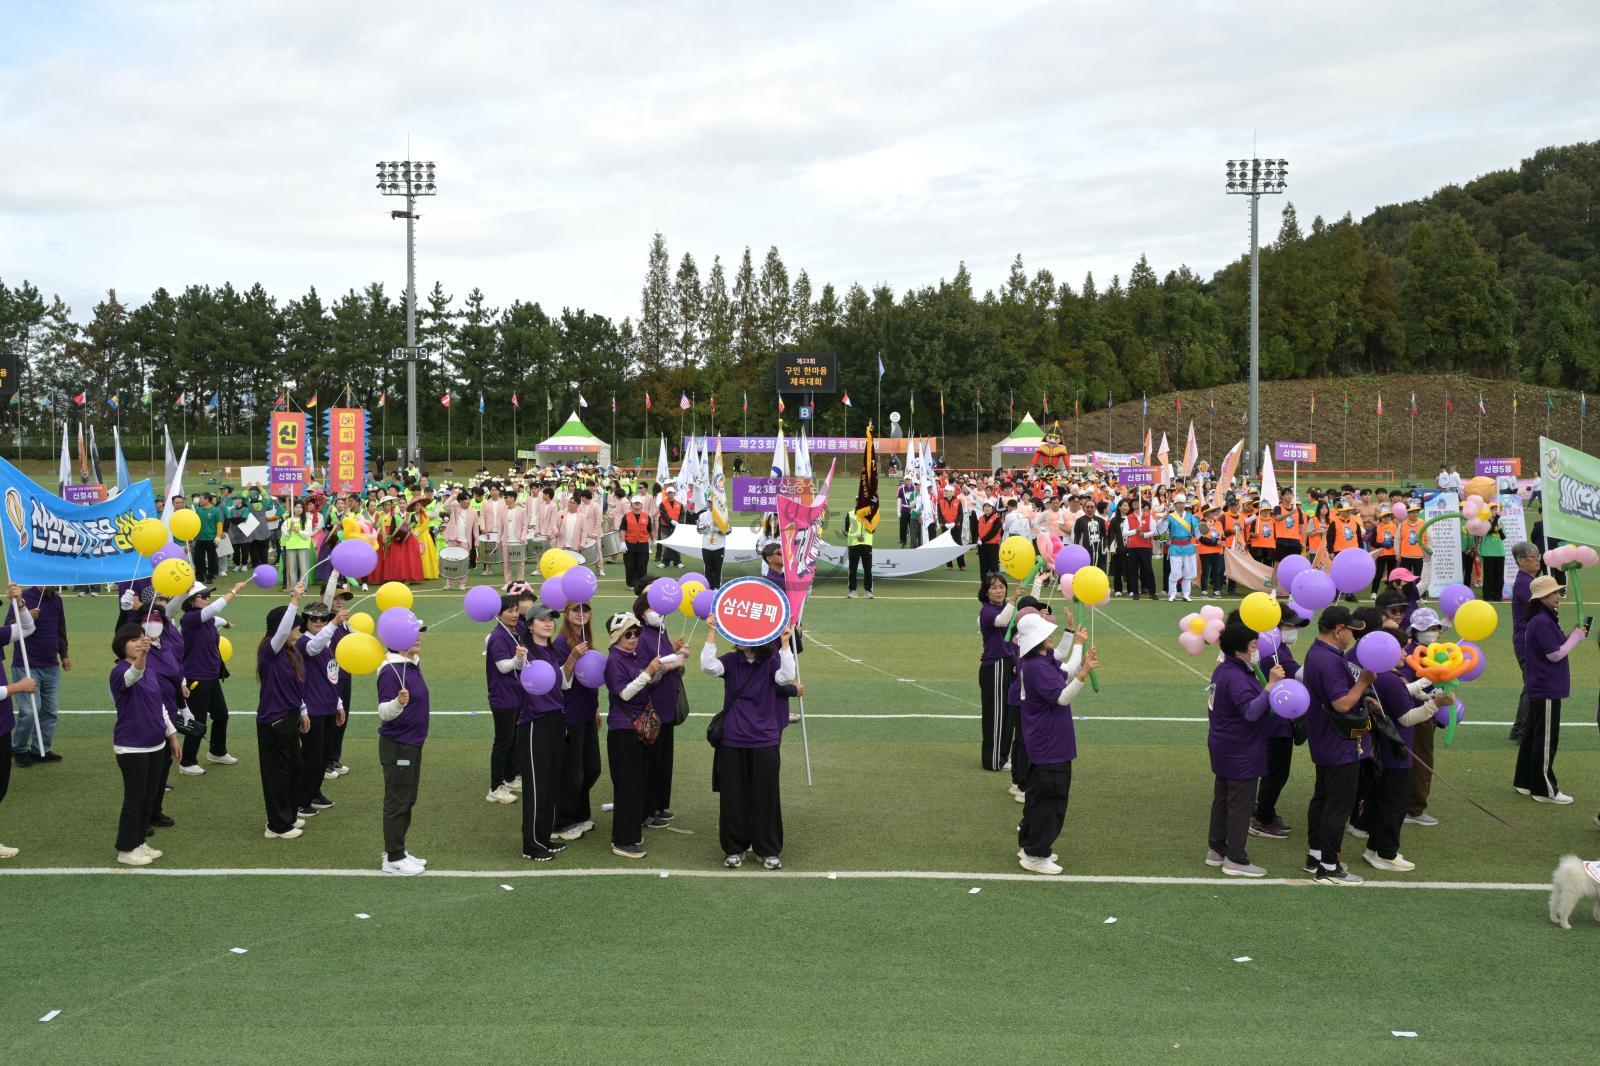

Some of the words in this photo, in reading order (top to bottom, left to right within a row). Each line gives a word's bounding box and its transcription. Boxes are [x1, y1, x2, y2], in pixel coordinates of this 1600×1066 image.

[391, 347, 428, 360] 10:19
[796, 357, 816, 365] 제23회
[784, 366, 801, 376] 구민
[804, 366, 828, 376] 한마음
[790, 377, 822, 386] 체육대회
[801, 407, 810, 418] B
[739, 439, 775, 449] 제23회
[1283, 449, 1309, 459] 신정3동
[1484, 464, 1512, 474] 신정5동
[278, 472, 304, 481] 신정2동
[1127, 473, 1152, 482] 신정1동
[748, 485, 776, 494] 제23회
[73, 491, 99, 500] 신정4동
[723, 597, 778, 623] 삼산불패
